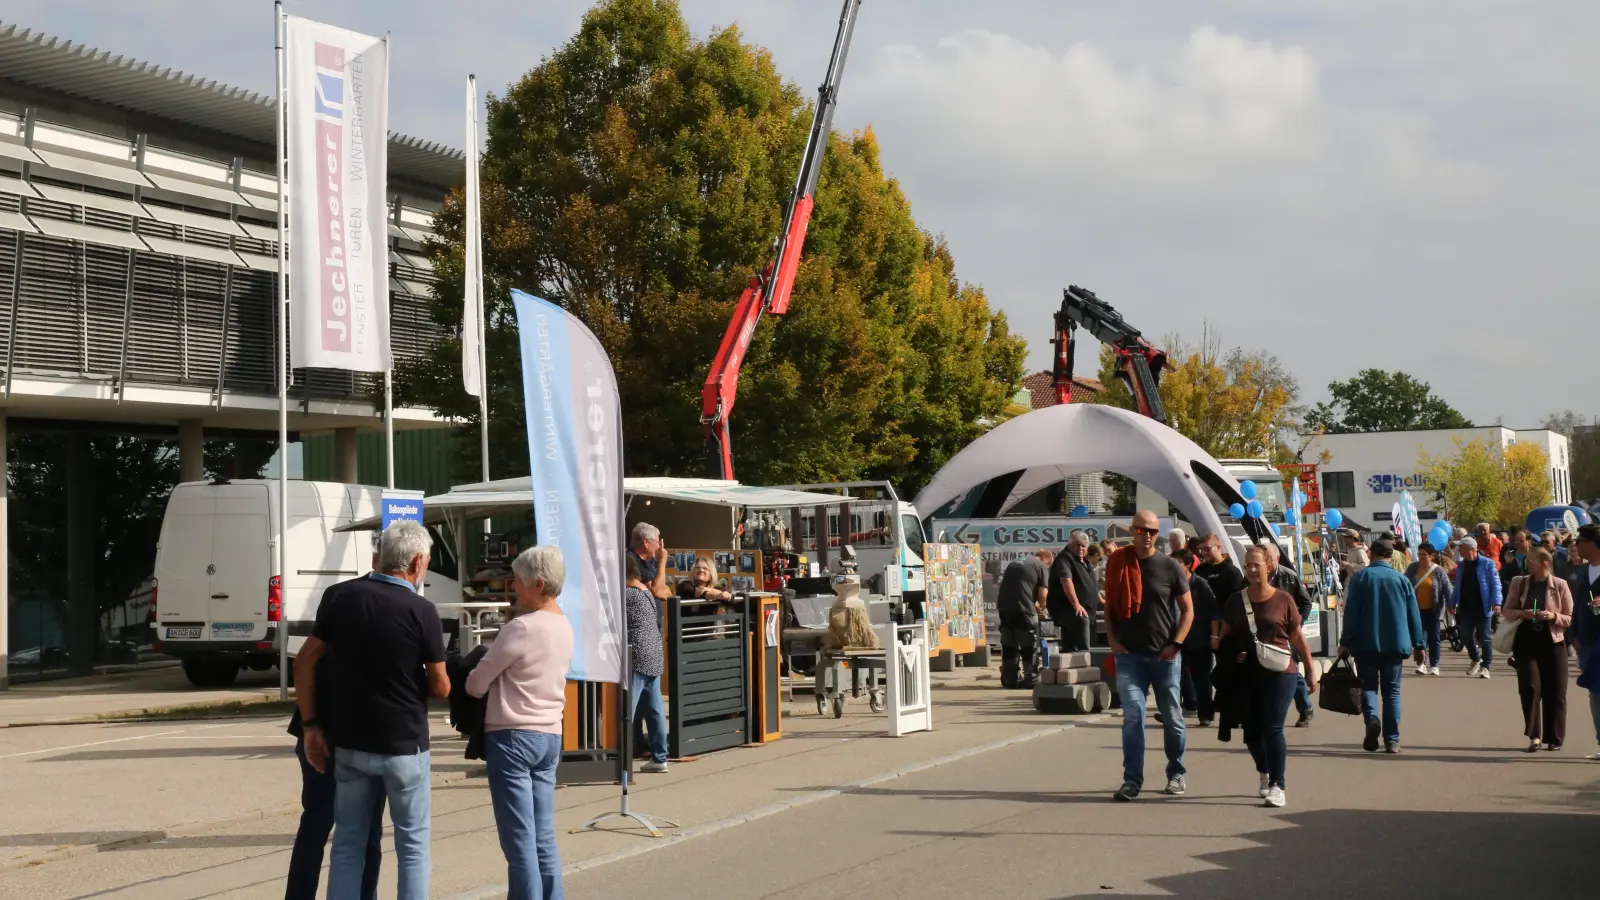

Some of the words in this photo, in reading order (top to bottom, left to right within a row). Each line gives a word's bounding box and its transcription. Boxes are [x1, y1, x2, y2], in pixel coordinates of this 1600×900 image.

[349, 52, 364, 182] WINTERGÄRTEN
[325, 133, 348, 343] Jechnerer
[993, 527, 1099, 545] GESSLR
